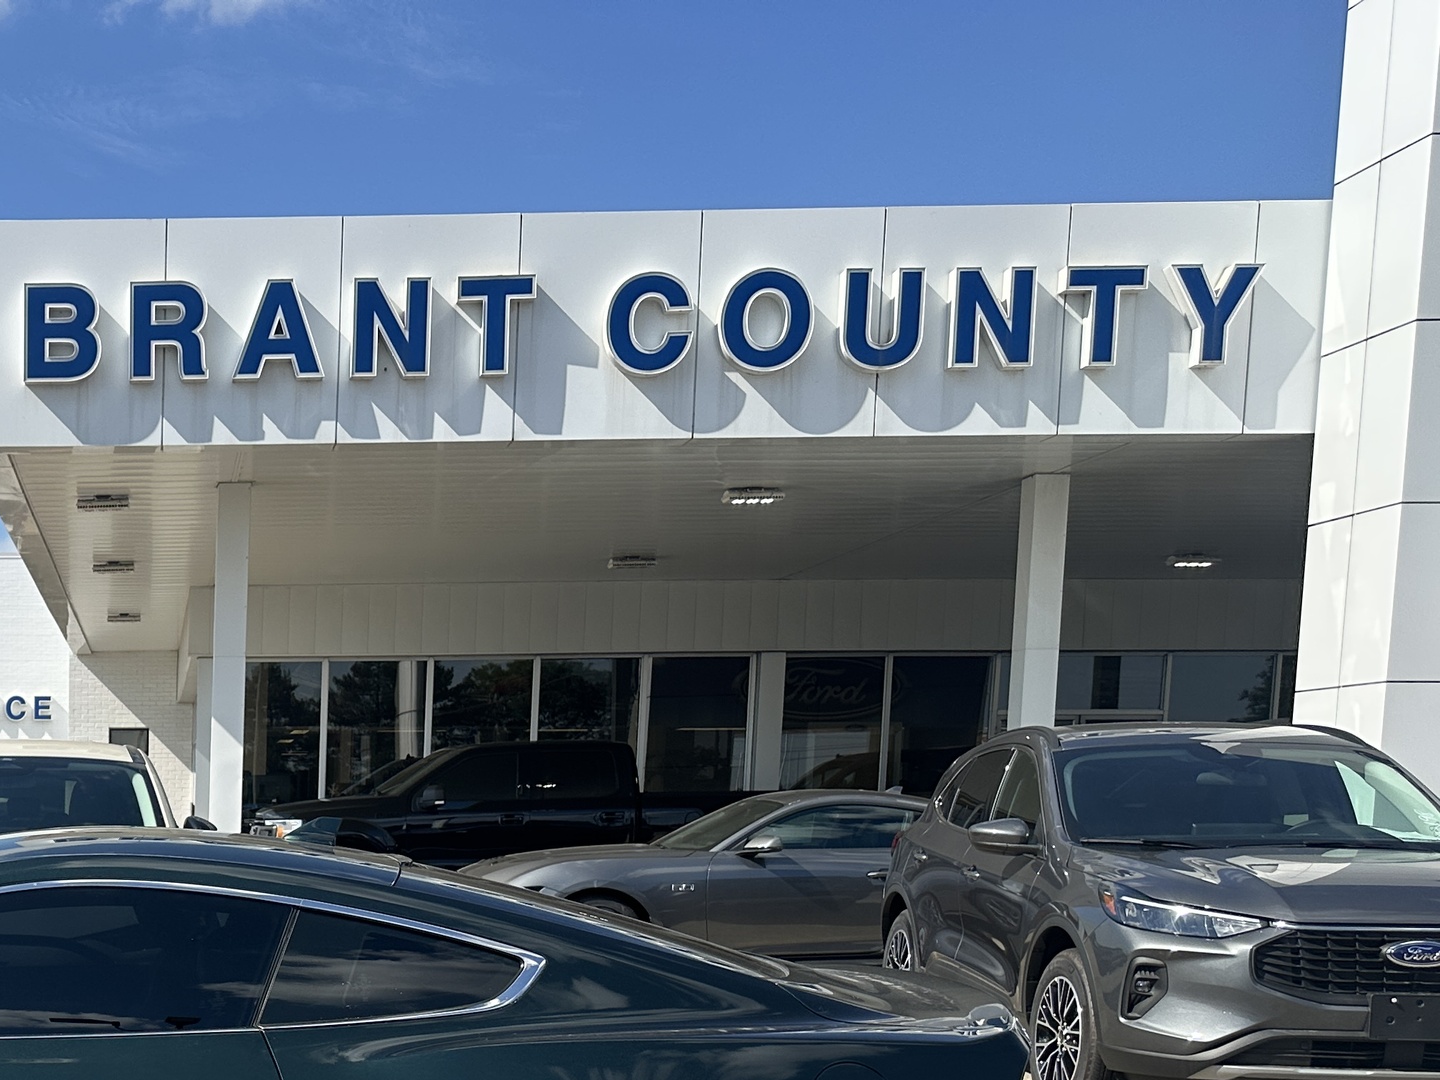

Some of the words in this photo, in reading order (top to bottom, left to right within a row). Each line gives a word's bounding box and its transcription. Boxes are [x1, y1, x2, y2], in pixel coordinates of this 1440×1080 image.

[23, 274, 538, 384] BRANT
[604, 262, 1267, 377] COUNTY
[785, 666, 869, 704] Ford
